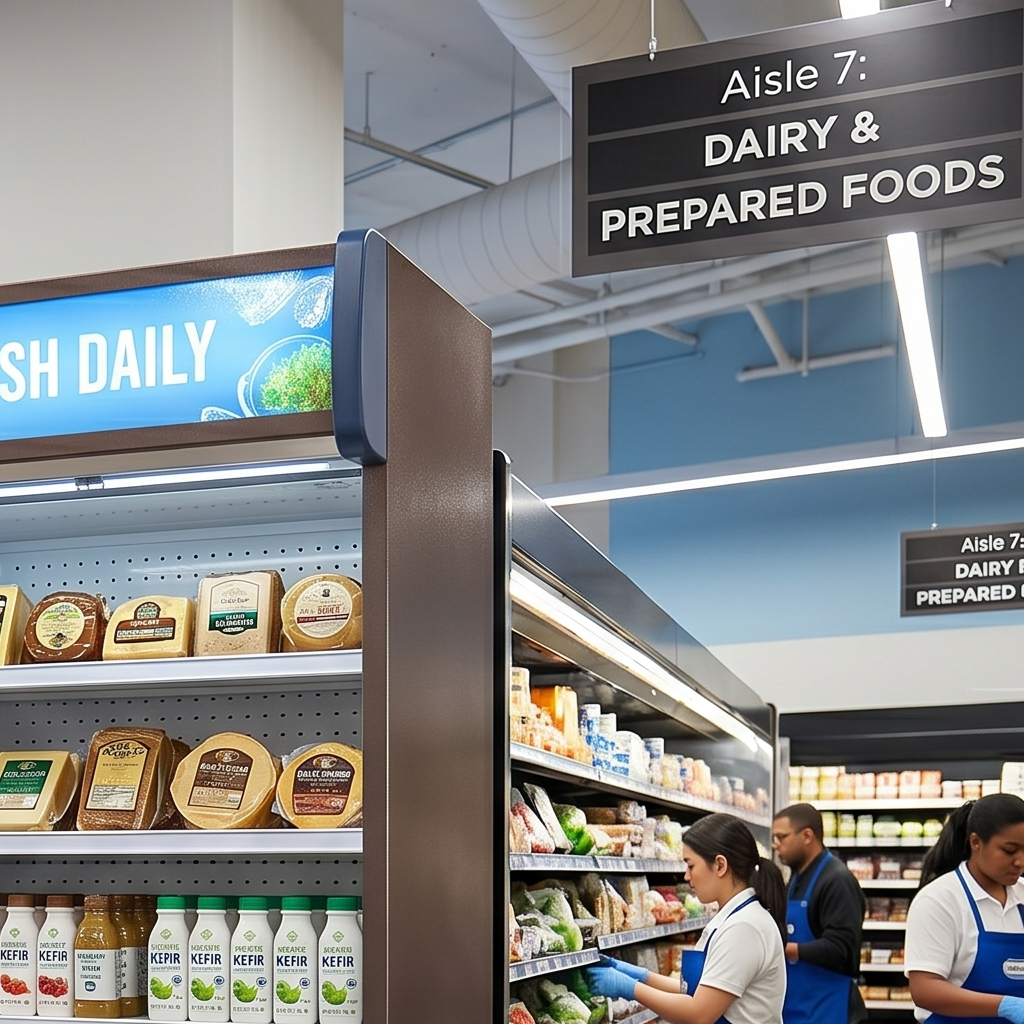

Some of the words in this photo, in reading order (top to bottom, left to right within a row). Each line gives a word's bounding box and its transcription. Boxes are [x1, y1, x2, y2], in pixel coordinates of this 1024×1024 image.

[720, 58, 819, 104] Aisle
[833, 49, 867, 86] 7:
[704, 114, 839, 168] DAIRY
[850, 110, 881, 144] &
[601, 181, 828, 243] PREPARED
[842, 153, 1006, 210] FOODS
[78, 318, 218, 396] DAILY
[960, 534, 1005, 553] Aisle
[955, 559, 1015, 579] DAIRY
[916, 584, 1017, 606] PREPARED
[0, 949, 29, 961] KEFIR
[39, 950, 68, 962] KEFIR
[191, 953, 222, 965] KEFIR
[232, 954, 265, 966] KEFIR
[276, 955, 308, 967] KEFIR
[322, 956, 355, 968] KEFIR
